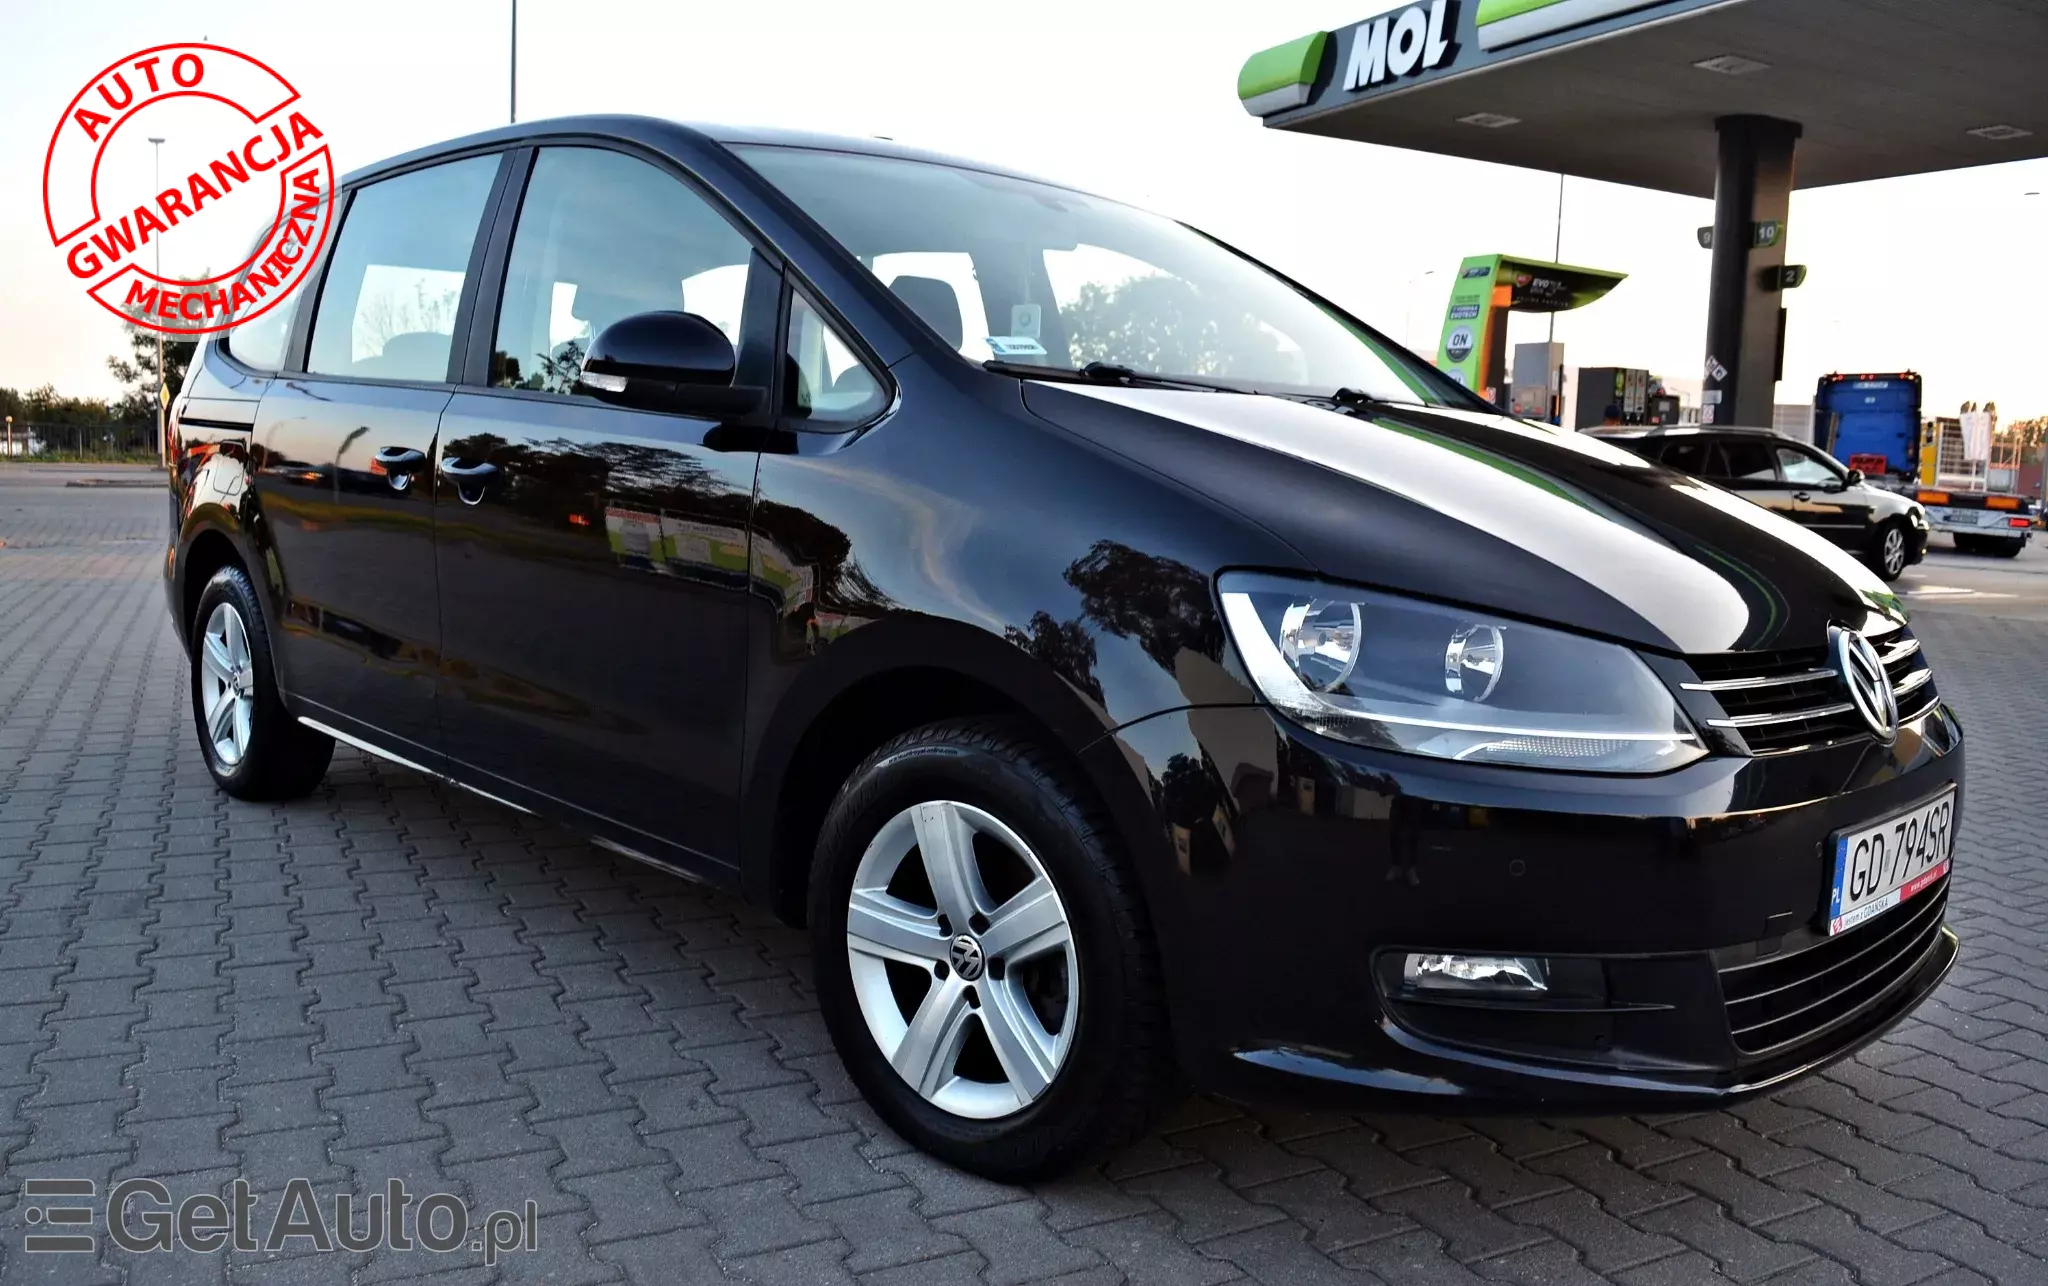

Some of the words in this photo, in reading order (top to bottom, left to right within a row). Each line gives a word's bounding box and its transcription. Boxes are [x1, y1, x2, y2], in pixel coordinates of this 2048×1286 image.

[1343, 0, 1449, 91] MOL
[1703, 232, 1711, 244] 9
[1758, 226, 1774, 240] 10
[1785, 270, 1796, 282] 2
[1452, 333, 1468, 346] ON
[1850, 832, 1885, 902] GD
[1888, 801, 1950, 887] 794SR
[1831, 886, 1841, 905] PL
